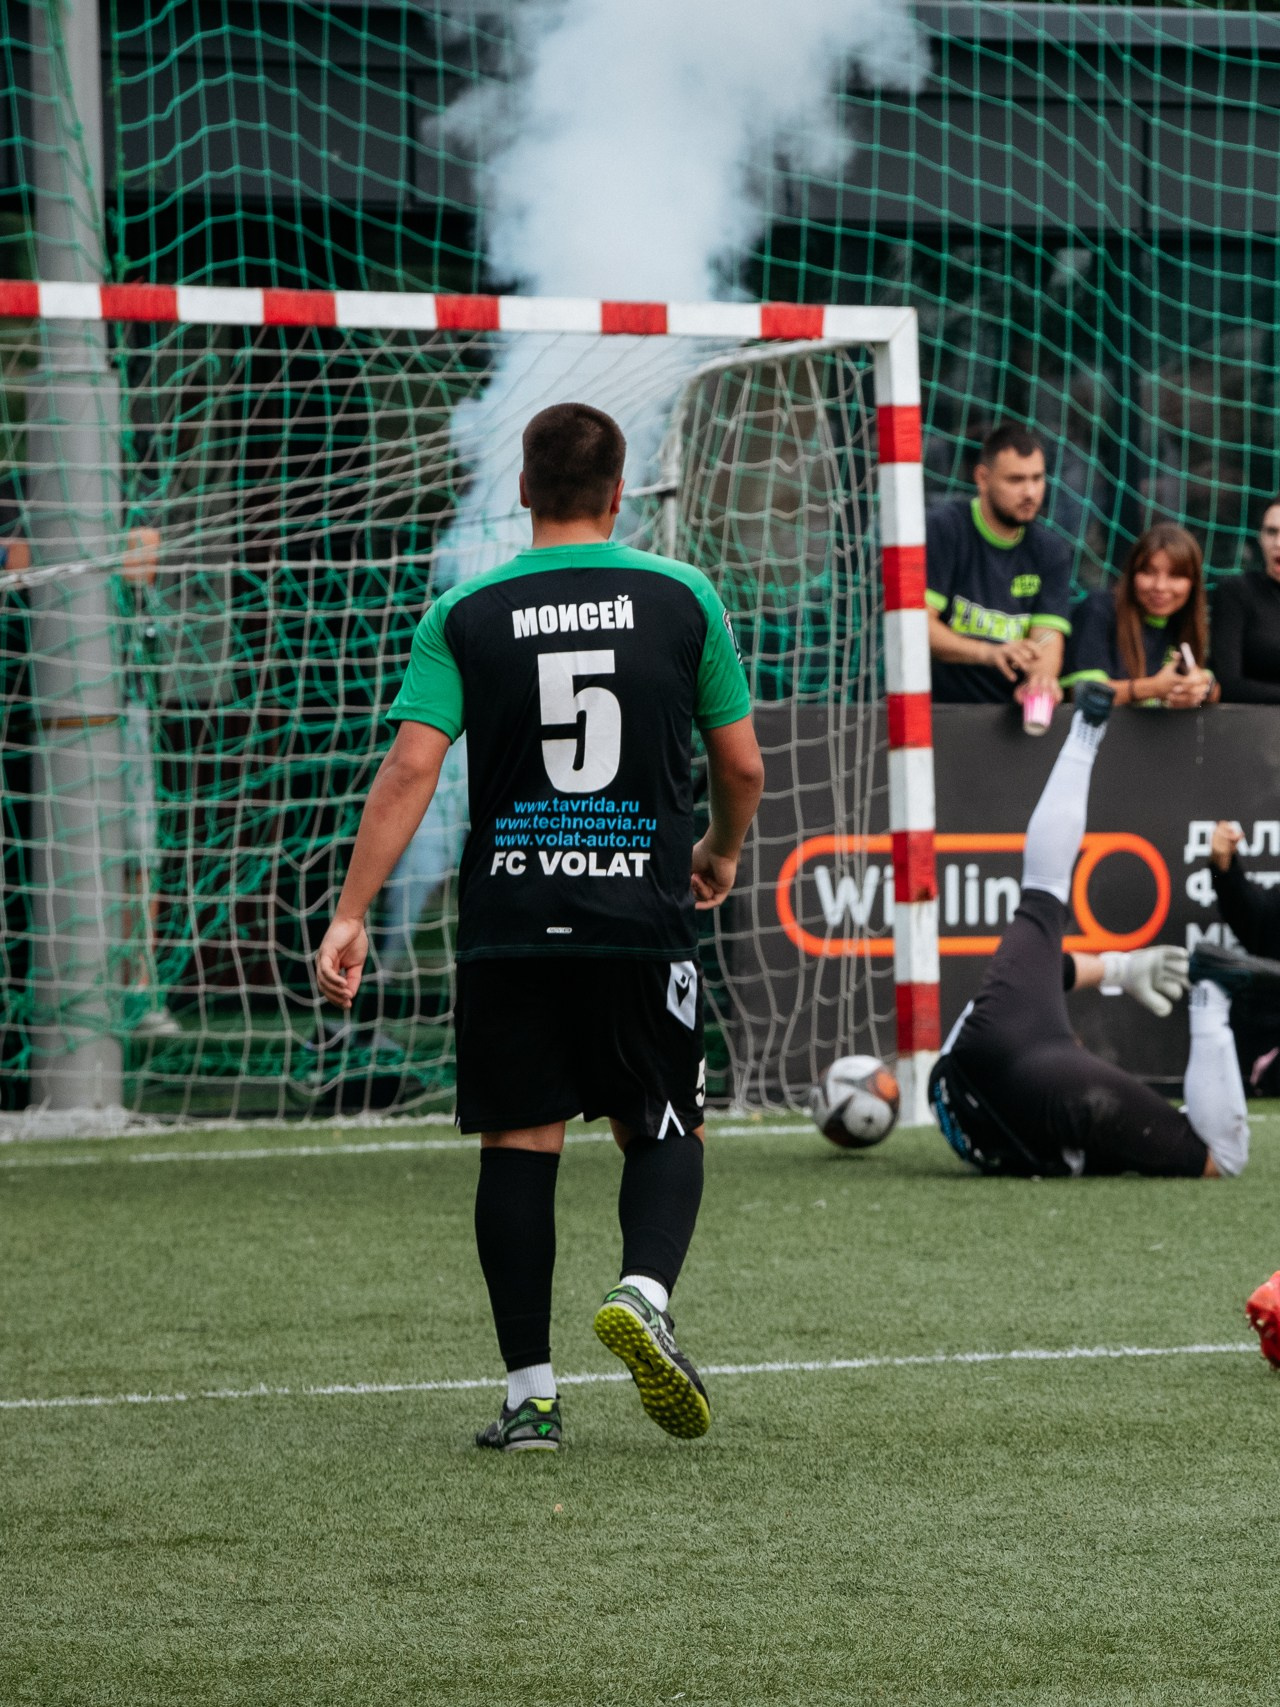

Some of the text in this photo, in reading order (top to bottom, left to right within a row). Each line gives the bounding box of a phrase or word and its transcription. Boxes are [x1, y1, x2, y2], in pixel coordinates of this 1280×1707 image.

[512, 595, 634, 639] МОИСЕЙ
[537, 650, 621, 793] 5
[513, 796, 639, 813] www.tavrida.ru
[495, 814, 657, 830] www.technoavia.ru
[494, 831, 651, 847] www.volat-auto.ru
[490, 851, 650, 877] FC VOLAT
[814, 864, 1021, 926] Wilin
